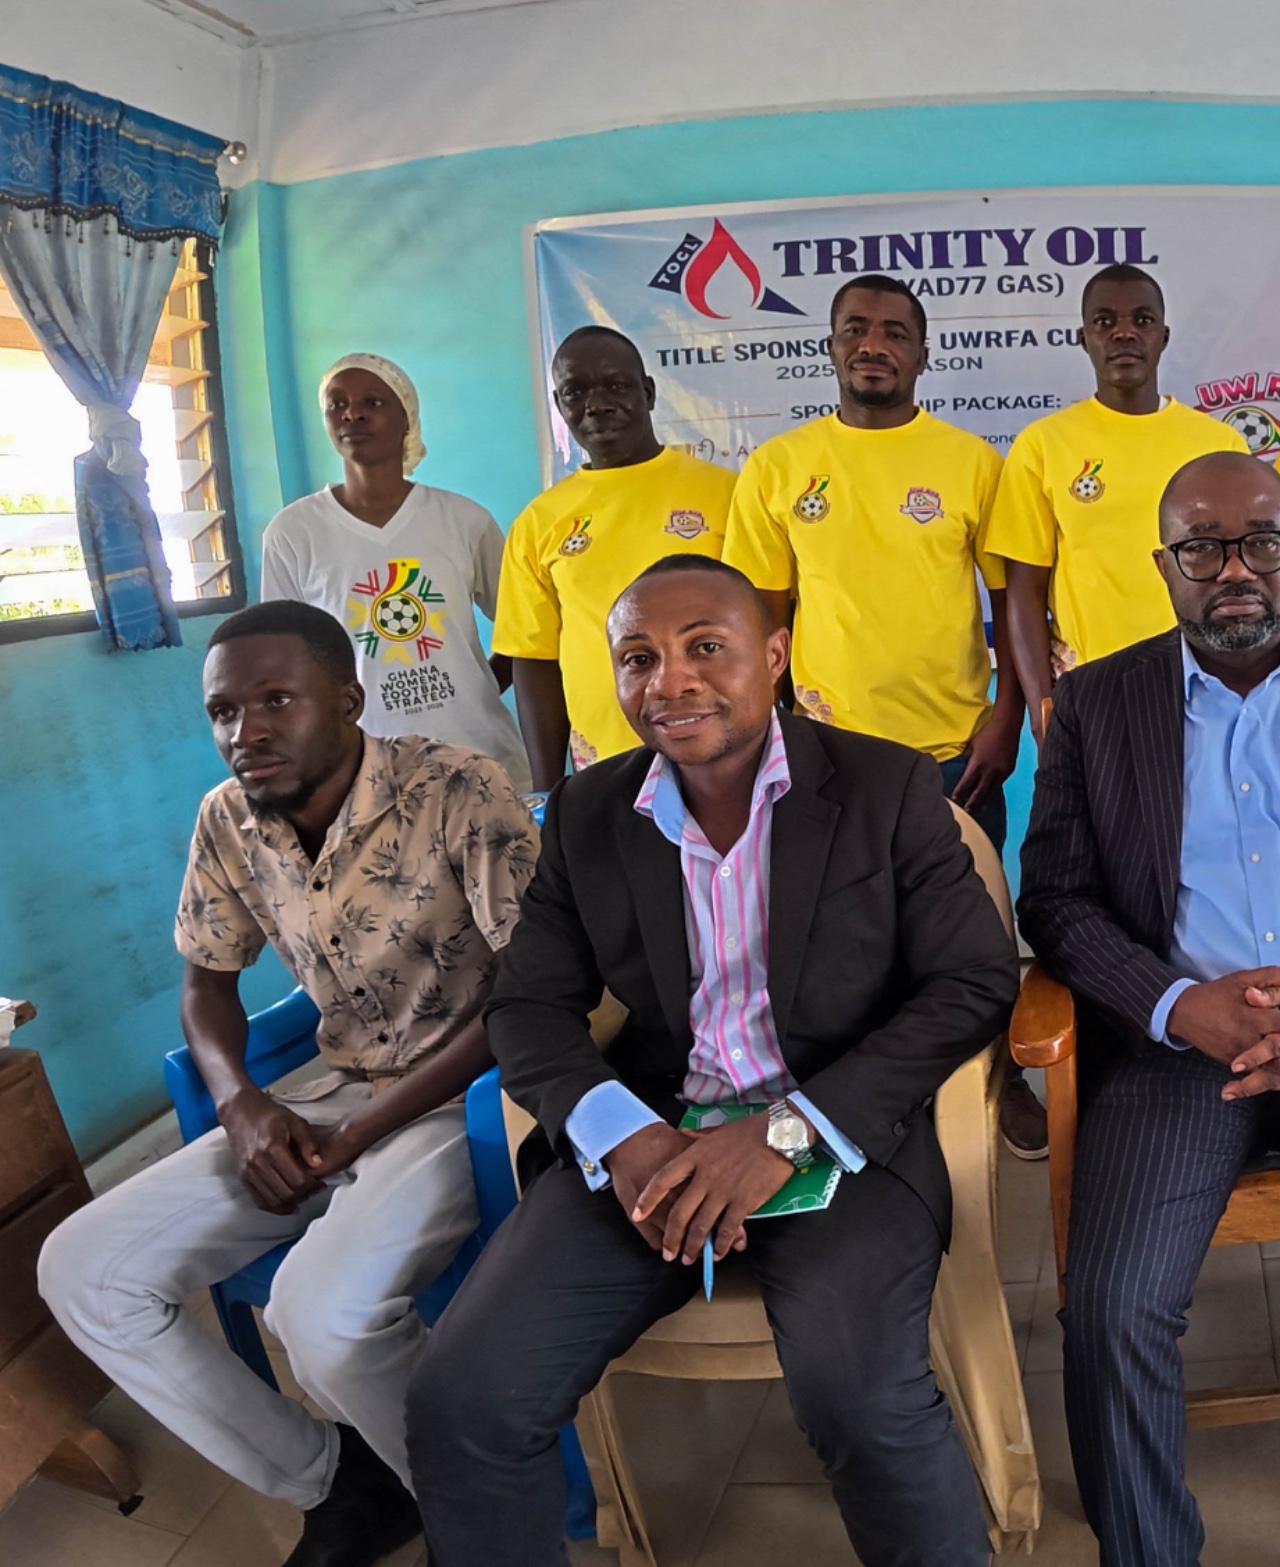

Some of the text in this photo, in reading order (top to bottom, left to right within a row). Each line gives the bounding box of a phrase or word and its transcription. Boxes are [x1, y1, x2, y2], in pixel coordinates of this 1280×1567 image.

[773, 226, 1159, 277] TRINITY OIL
[658, 242, 699, 284] TOCL
[997, 273, 1064, 298] GAS)
[940, 329, 1038, 350] UWRFA
[656, 346, 726, 367] TITLE
[953, 395, 1062, 411] PACKAGE:
[388, 665, 440, 682] GHANA
[381, 680, 455, 702] FOOTBALL
[385, 689, 455, 710] STRATEGY
